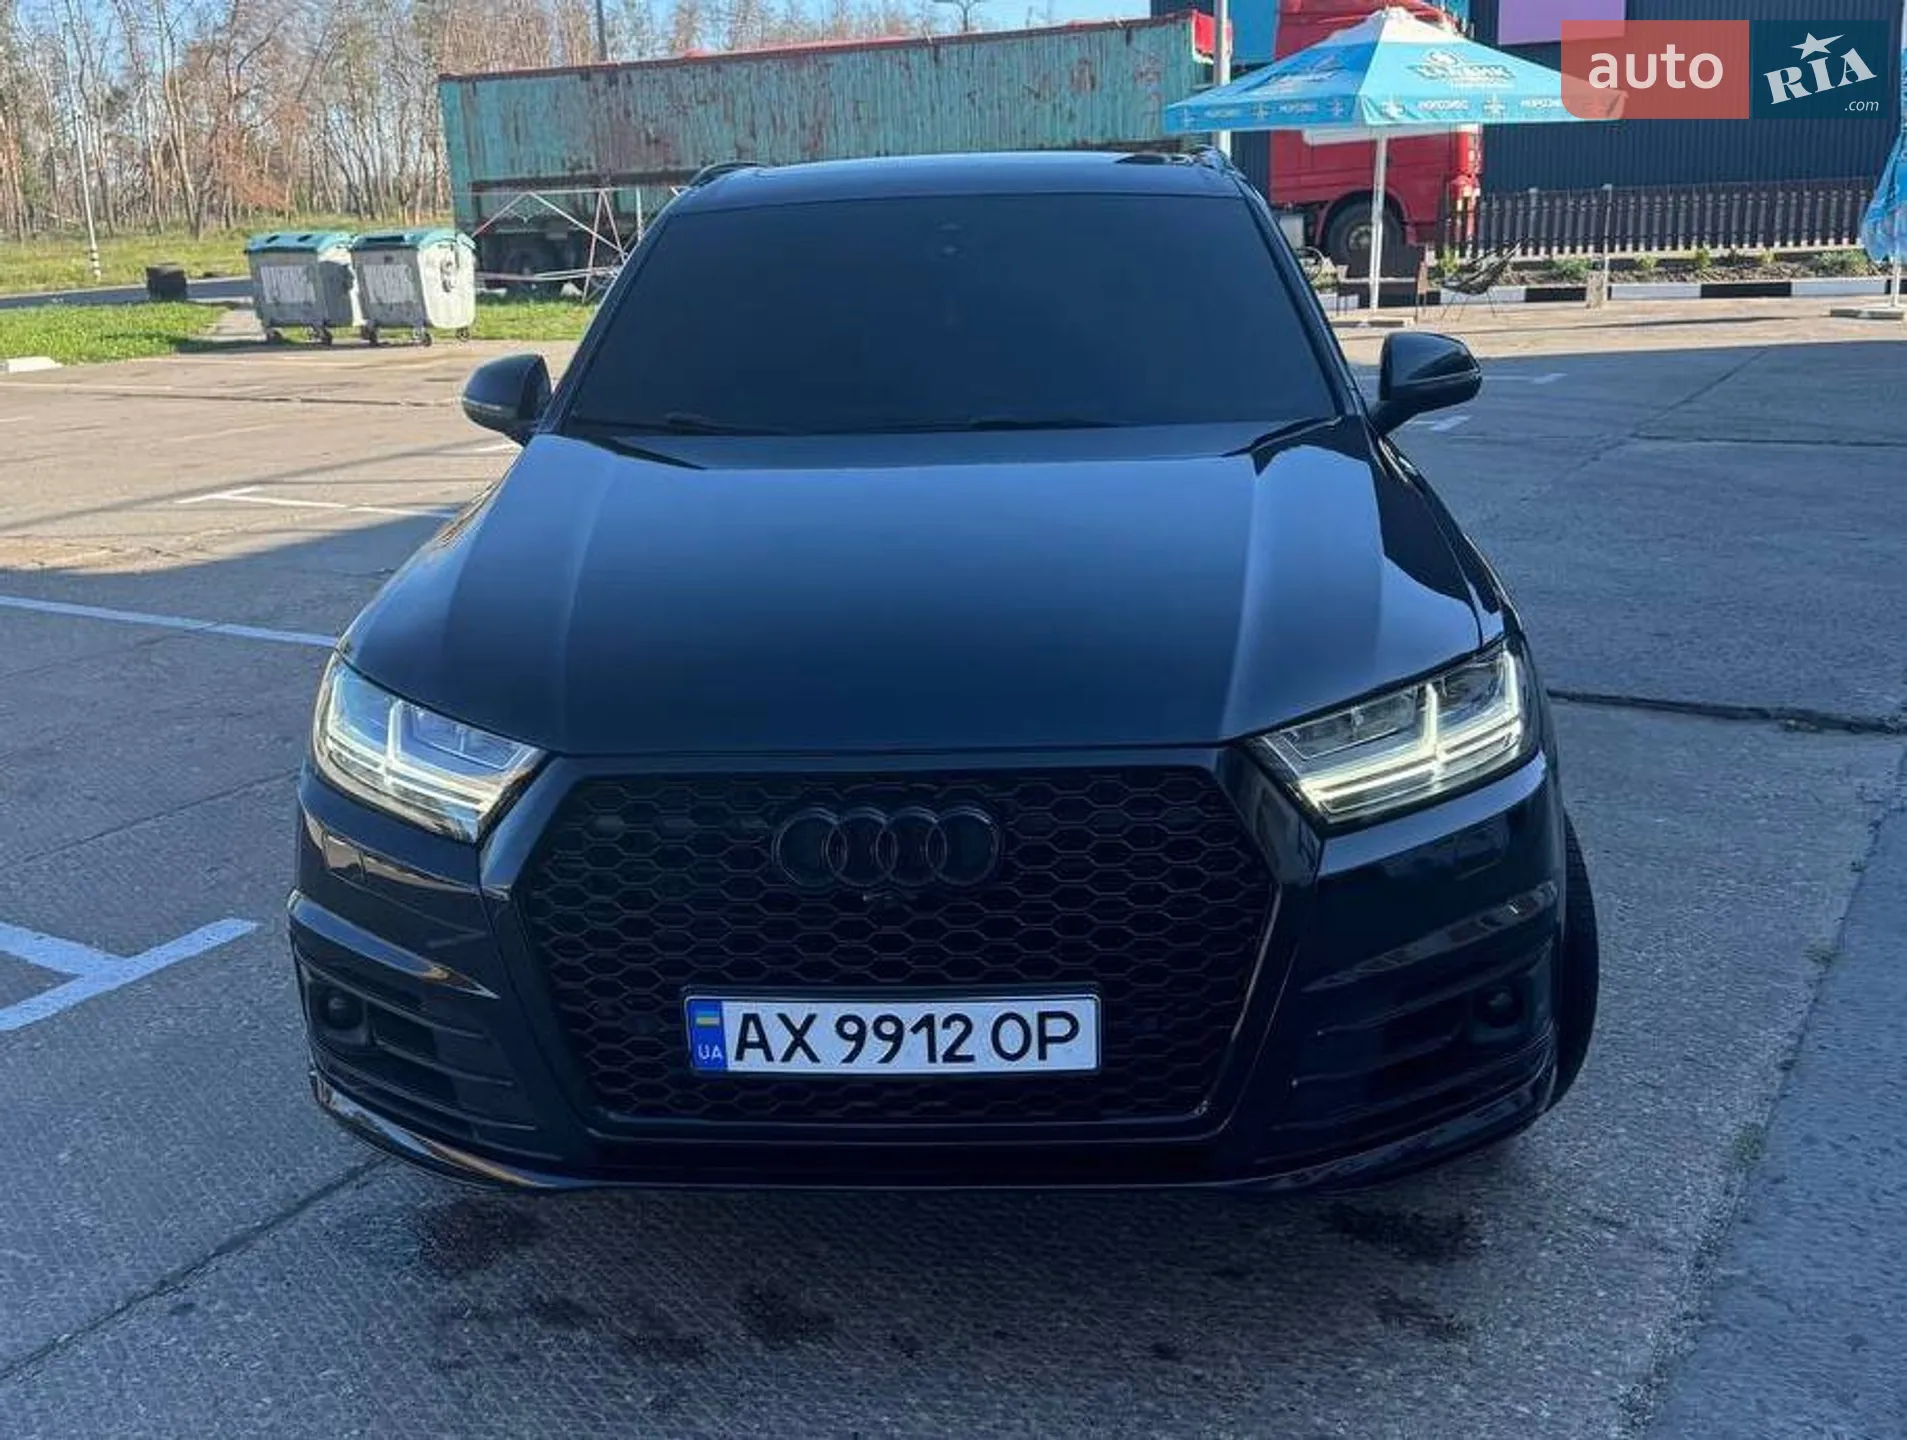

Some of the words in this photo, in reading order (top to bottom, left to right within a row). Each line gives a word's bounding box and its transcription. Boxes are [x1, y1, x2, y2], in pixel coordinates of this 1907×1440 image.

[698, 1044, 724, 1060] UA
[734, 1013, 821, 1063] AX
[835, 1013, 975, 1064] 9912
[991, 1011, 1080, 1062] OP
